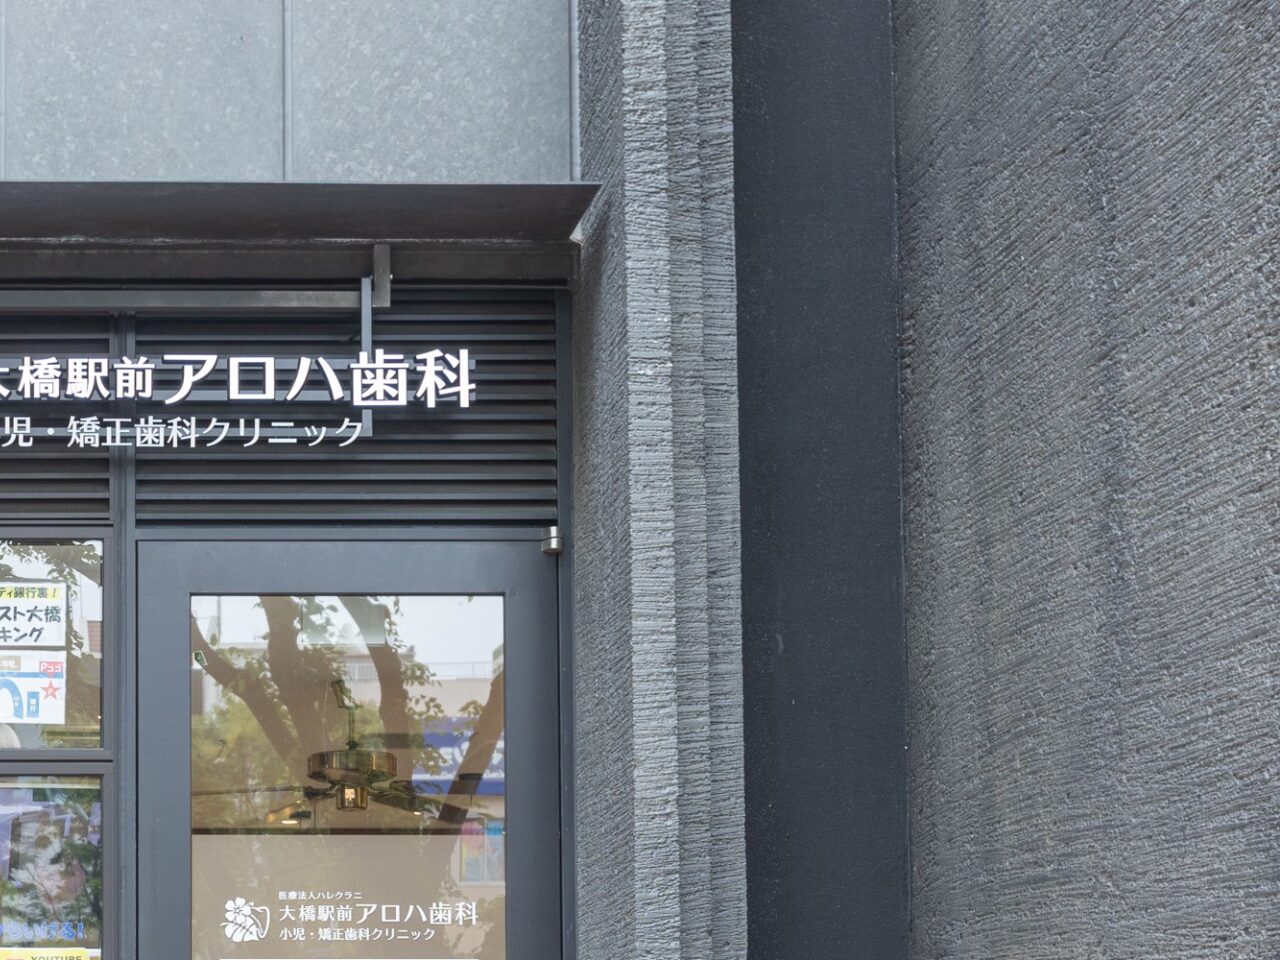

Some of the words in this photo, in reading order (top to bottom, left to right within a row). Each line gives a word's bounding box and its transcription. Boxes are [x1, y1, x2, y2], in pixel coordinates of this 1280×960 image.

[278, 891, 363, 900] 医療法人ハレクラニ
[279, 902, 479, 926] 大橋駅前アロハ歯科
[279, 927, 435, 942] 小児・矯正歯科クリニック
